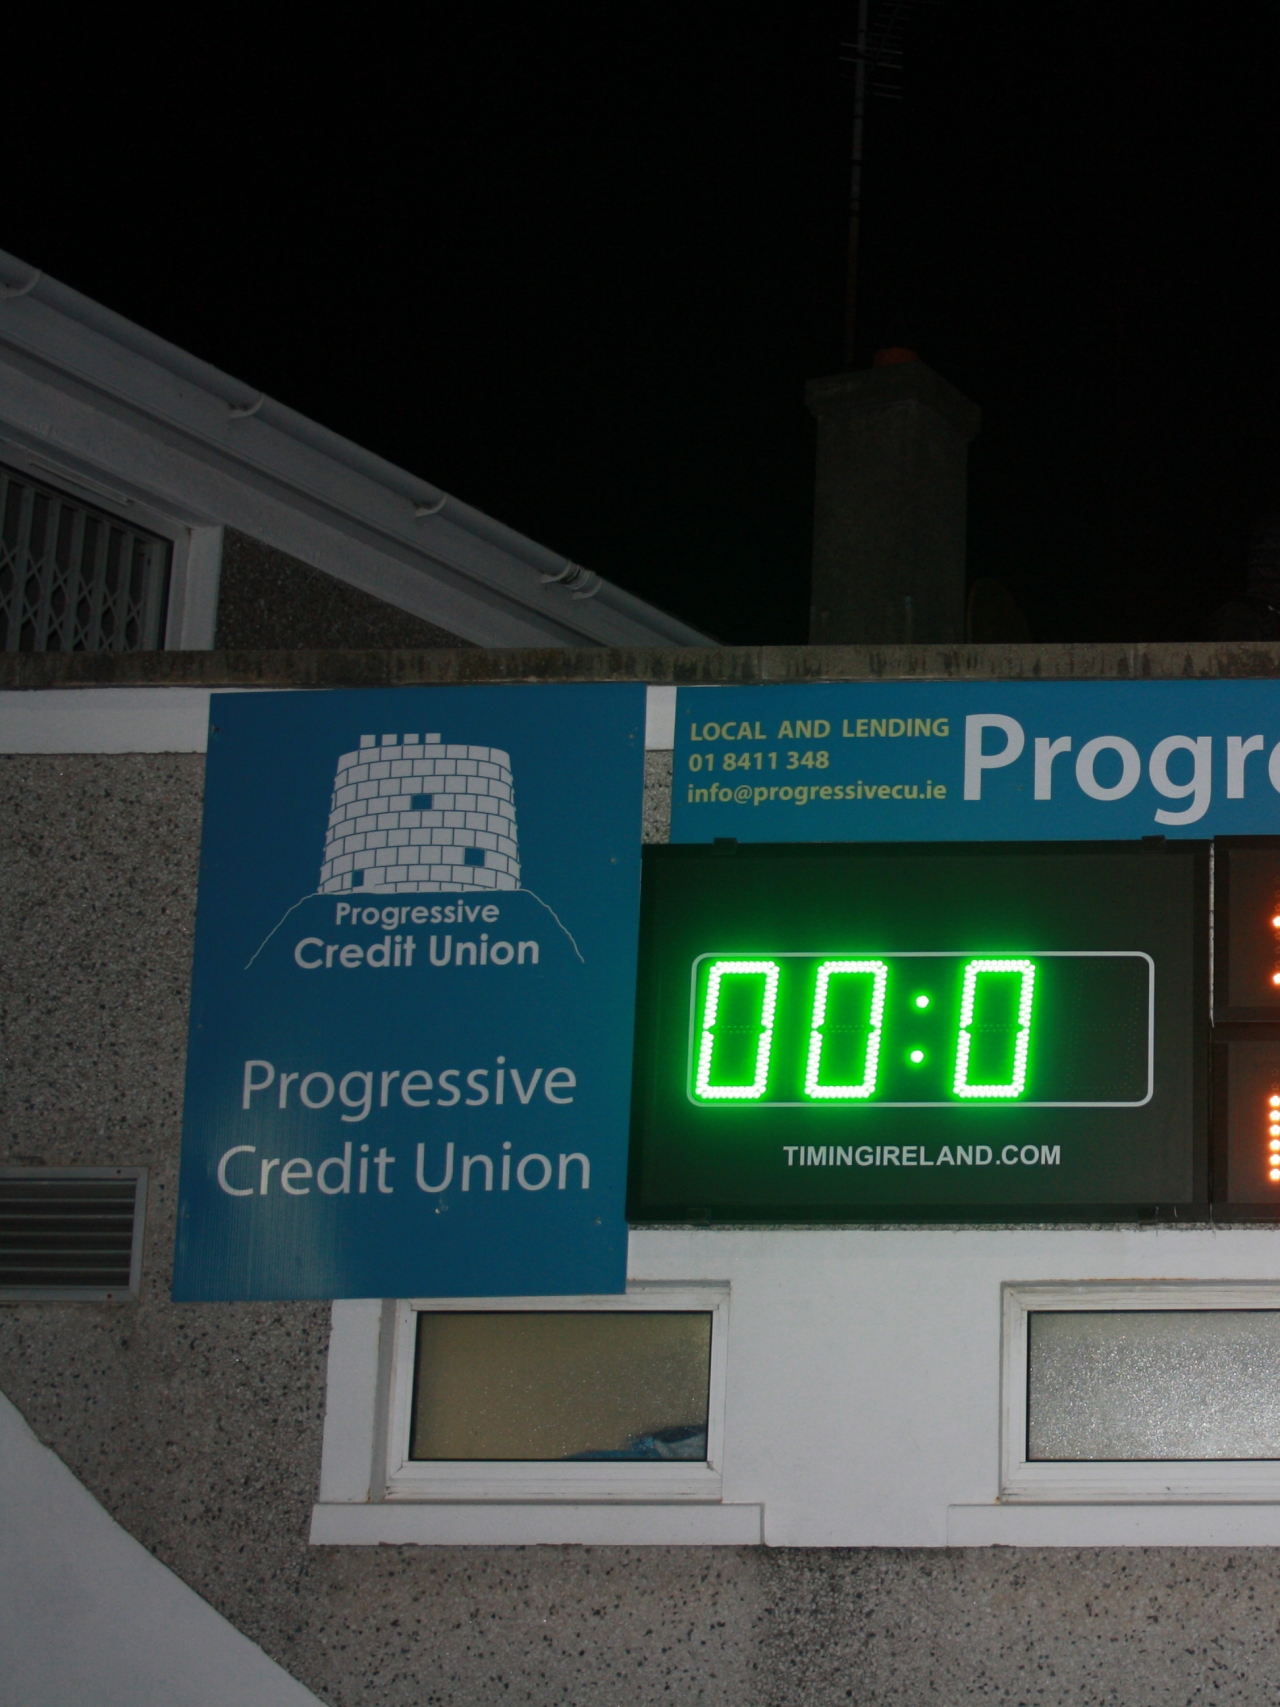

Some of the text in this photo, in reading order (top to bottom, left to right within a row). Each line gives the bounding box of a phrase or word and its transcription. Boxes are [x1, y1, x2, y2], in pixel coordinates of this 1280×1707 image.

[690, 717, 950, 742] LOCAL AND LENDING
[689, 750, 829, 772] 01 8411 348
[687, 780, 948, 806] info@progressivecu.ie
[335, 900, 500, 930] Progressive
[294, 933, 540, 970] Credit Union
[242, 1056, 576, 1122] Progressive
[217, 1141, 591, 1197] Credit Union
[783, 1144, 1062, 1167] TIMINGIRELAND.COM
